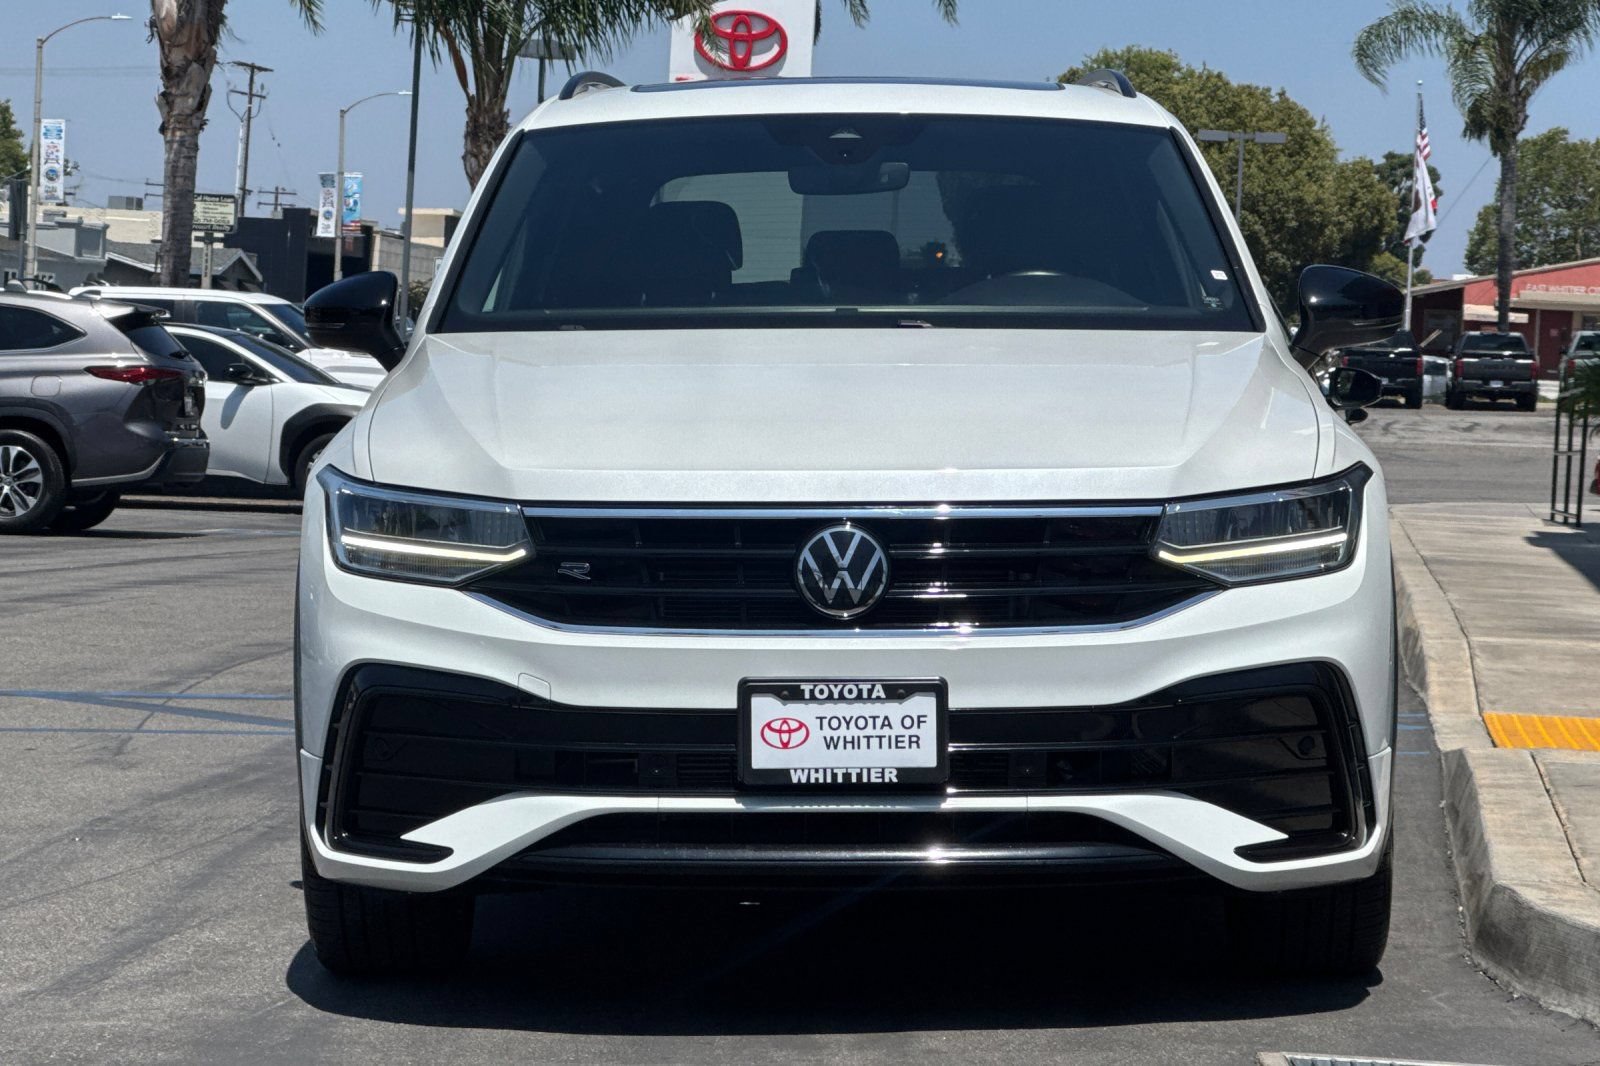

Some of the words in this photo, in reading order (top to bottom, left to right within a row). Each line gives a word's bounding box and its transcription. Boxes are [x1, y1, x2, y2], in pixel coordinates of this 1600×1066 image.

[1526, 283, 1547, 291] EAST
[1548, 285, 1586, 294] WHITTIER
[800, 684, 886, 700] TOYOTA
[815, 715, 893, 731] TOYOTA
[900, 714, 928, 730] OF
[823, 735, 921, 750] WHITTIER
[789, 768, 898, 784] WHITTIER
